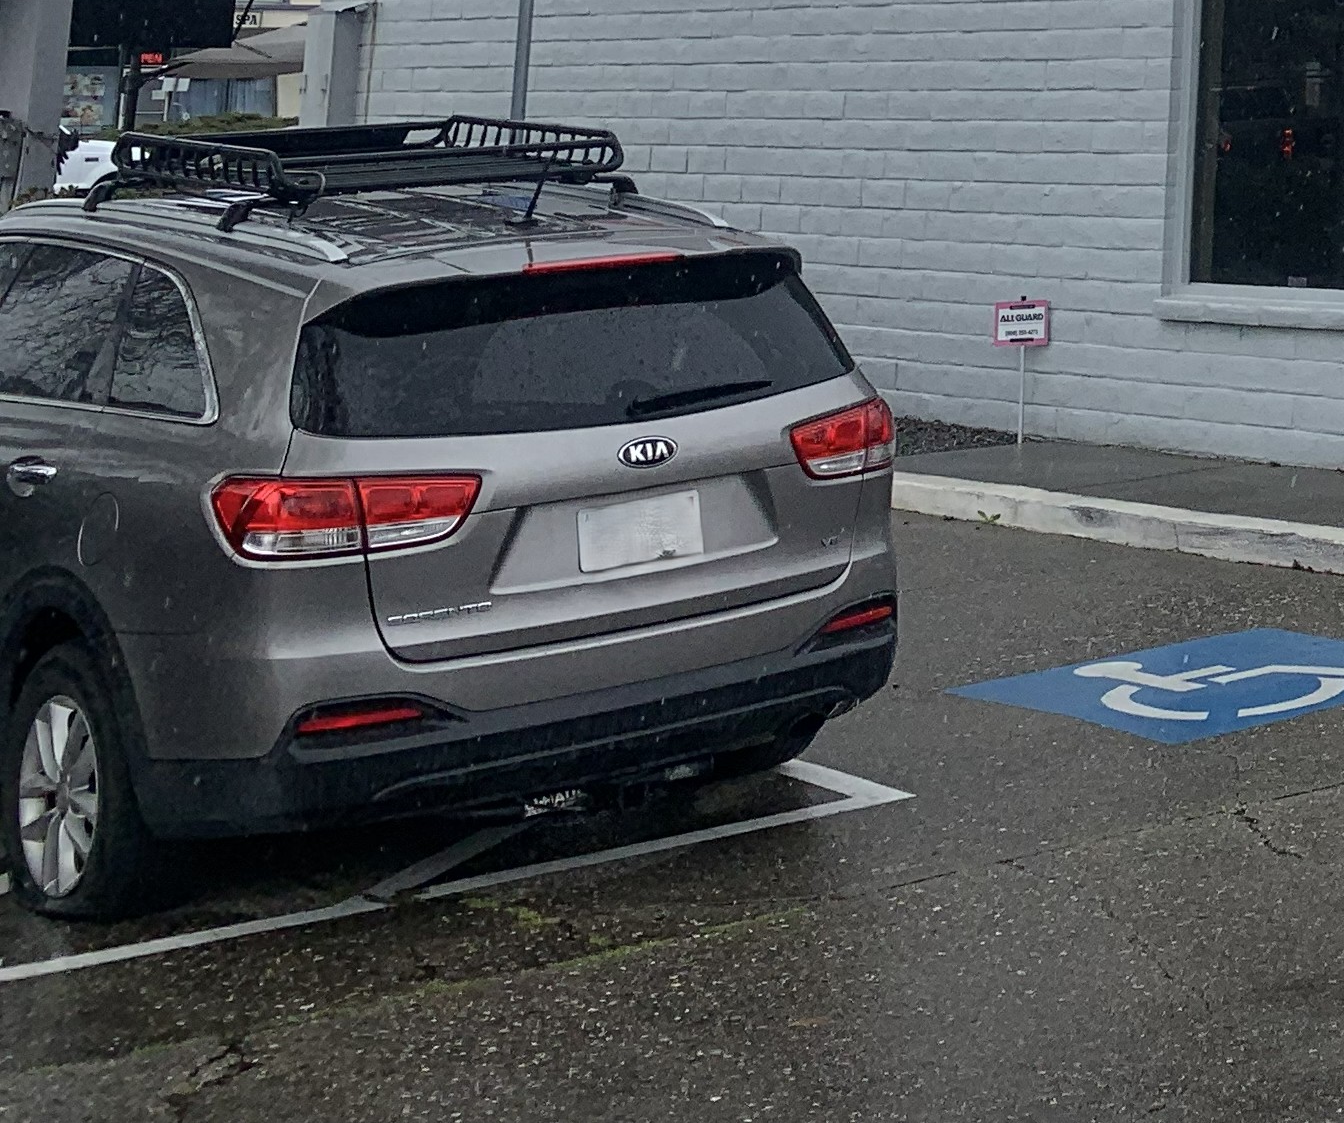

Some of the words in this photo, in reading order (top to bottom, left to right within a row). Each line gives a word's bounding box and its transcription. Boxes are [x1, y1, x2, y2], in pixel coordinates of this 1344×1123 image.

[235, 14, 258, 26] SPA
[140, 52, 163, 64] PEN
[628, 441, 670, 463] KIA
